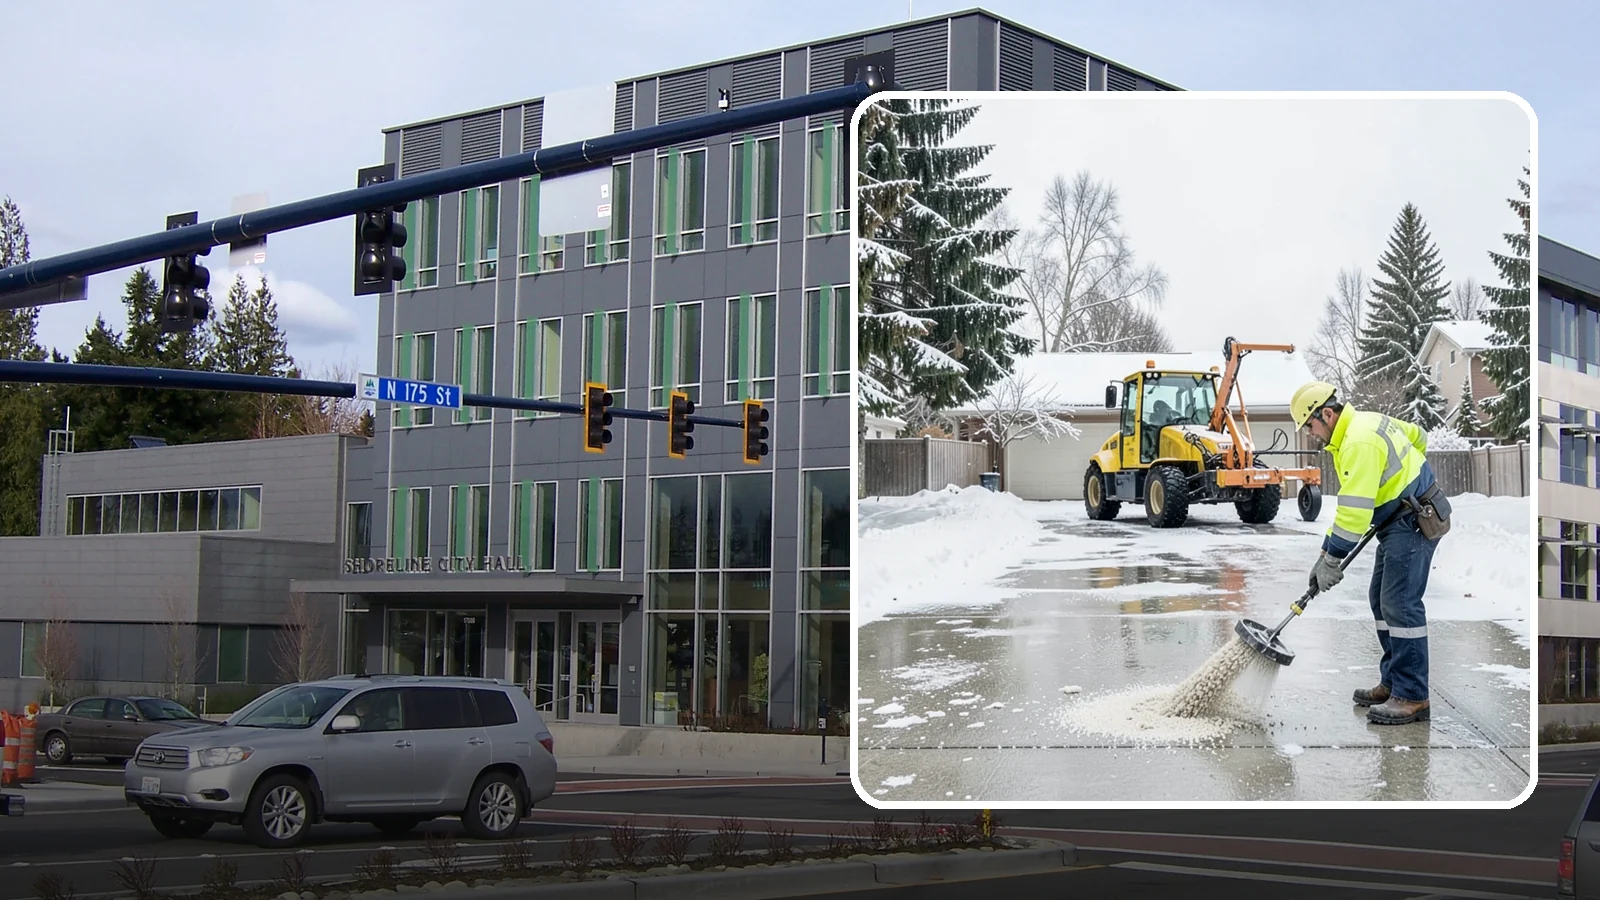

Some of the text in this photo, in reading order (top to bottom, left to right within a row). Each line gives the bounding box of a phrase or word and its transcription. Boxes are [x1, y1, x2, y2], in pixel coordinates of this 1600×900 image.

[387, 380, 451, 406] N 175 St
[343, 555, 525, 574] SHORELINE CITY HALL
